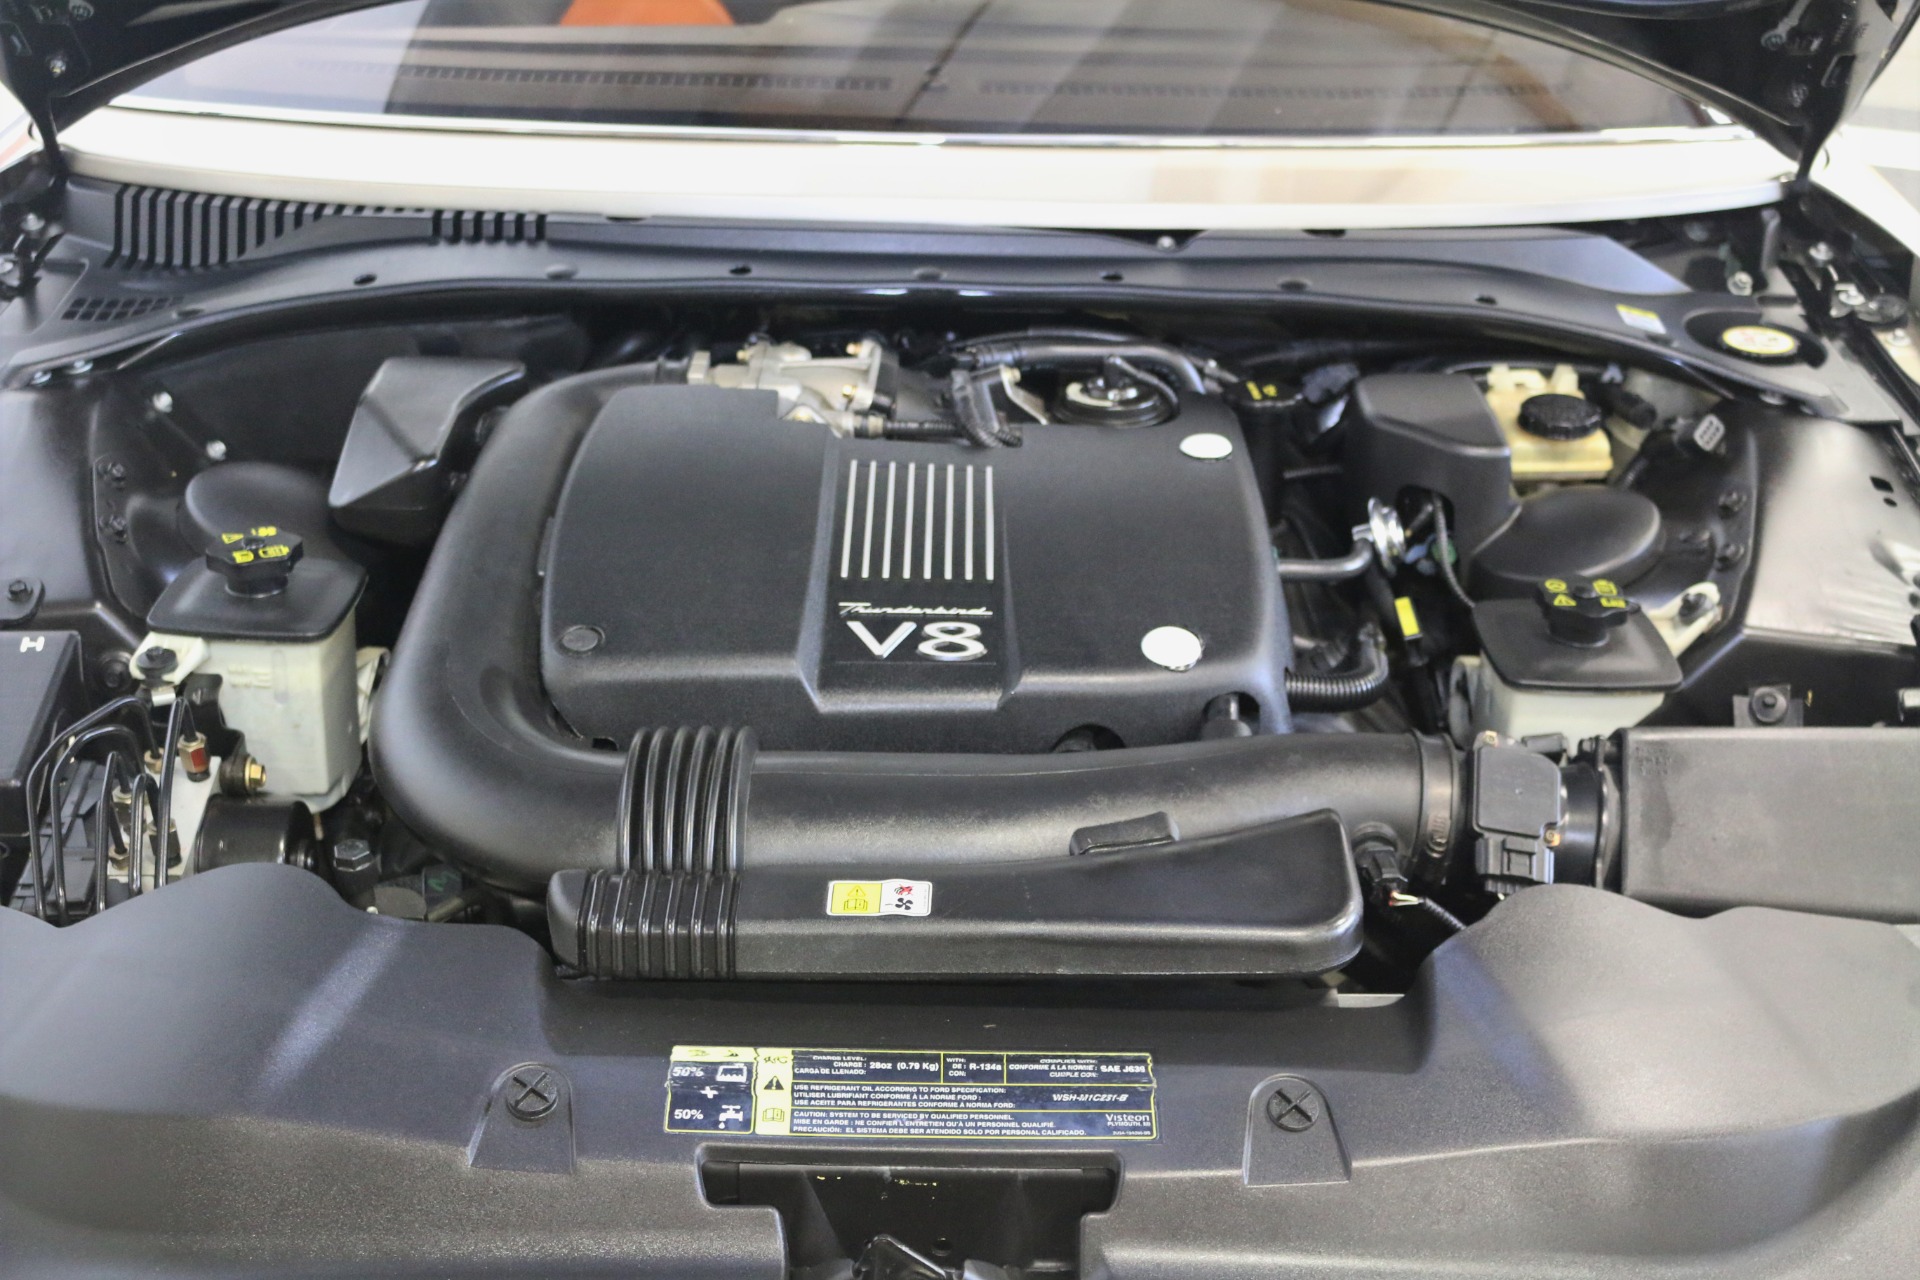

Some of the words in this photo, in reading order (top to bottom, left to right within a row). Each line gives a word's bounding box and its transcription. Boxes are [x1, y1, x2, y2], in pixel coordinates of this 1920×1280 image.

[838, 602, 993, 617] Thunderbird
[846, 621, 988, 661] V8
[672, 1066, 704, 1077] 50%
[896, 1062, 920, 1071] (0.79
[922, 1062, 939, 1071] Kg)
[674, 1109, 704, 1120] 50%
[1105, 1114, 1150, 1122] Visteon
